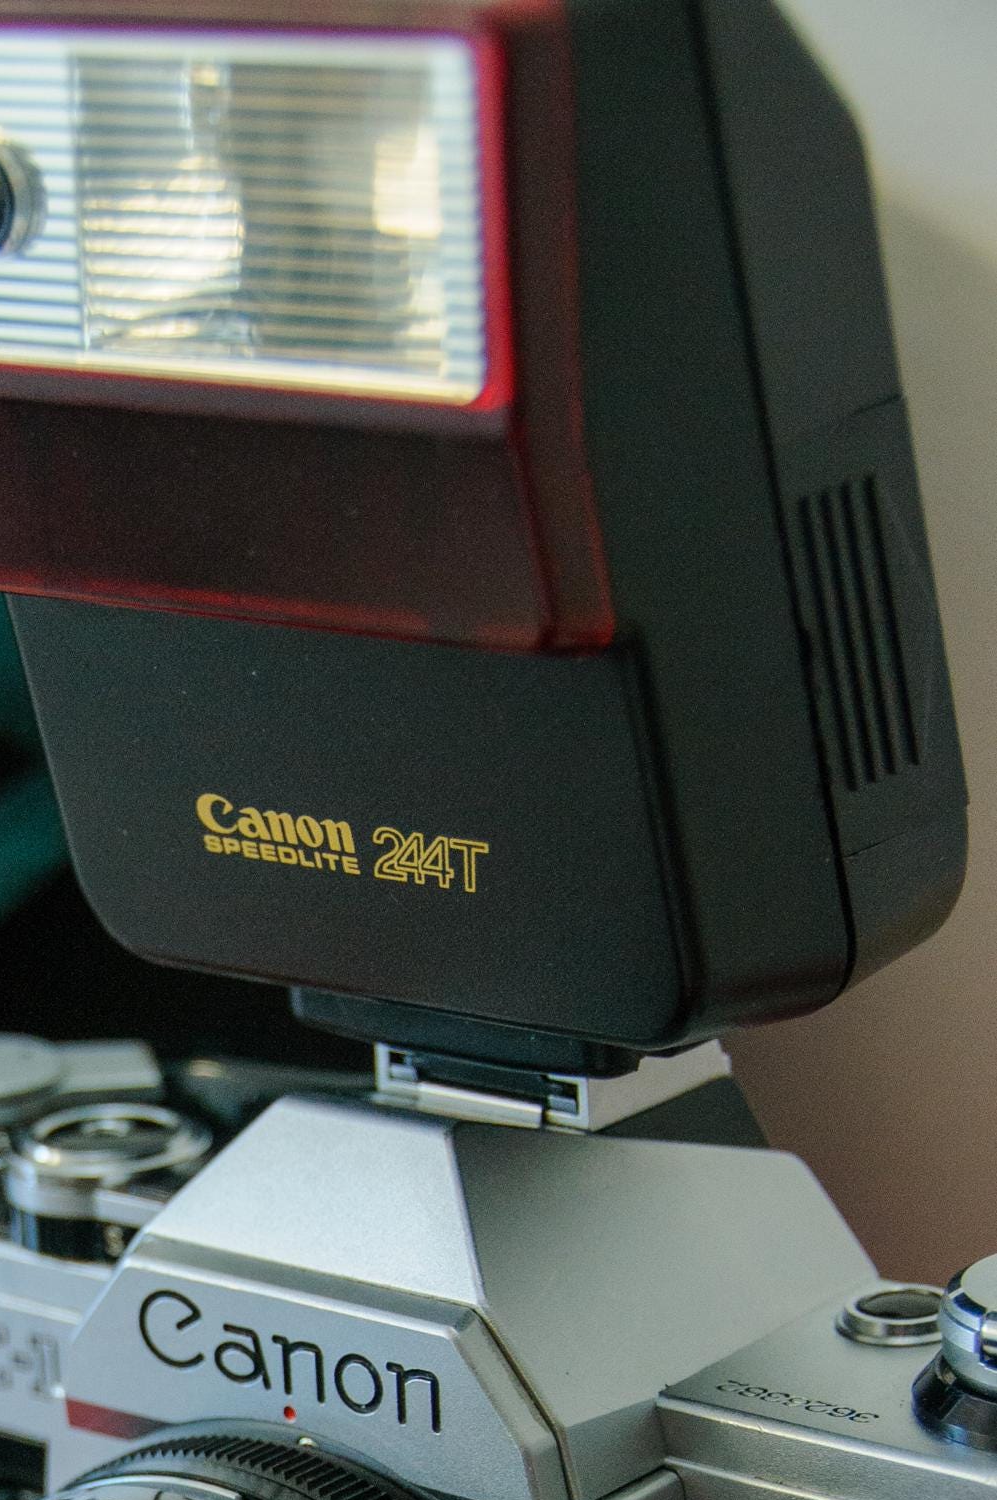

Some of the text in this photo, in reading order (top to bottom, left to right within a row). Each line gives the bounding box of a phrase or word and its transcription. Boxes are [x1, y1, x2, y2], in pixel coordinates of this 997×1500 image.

[196, 793, 355, 853] Canon
[204, 834, 361, 875] SPEEDLITE
[372, 826, 489, 893] 244T
[138, 1288, 442, 1434] Canon
